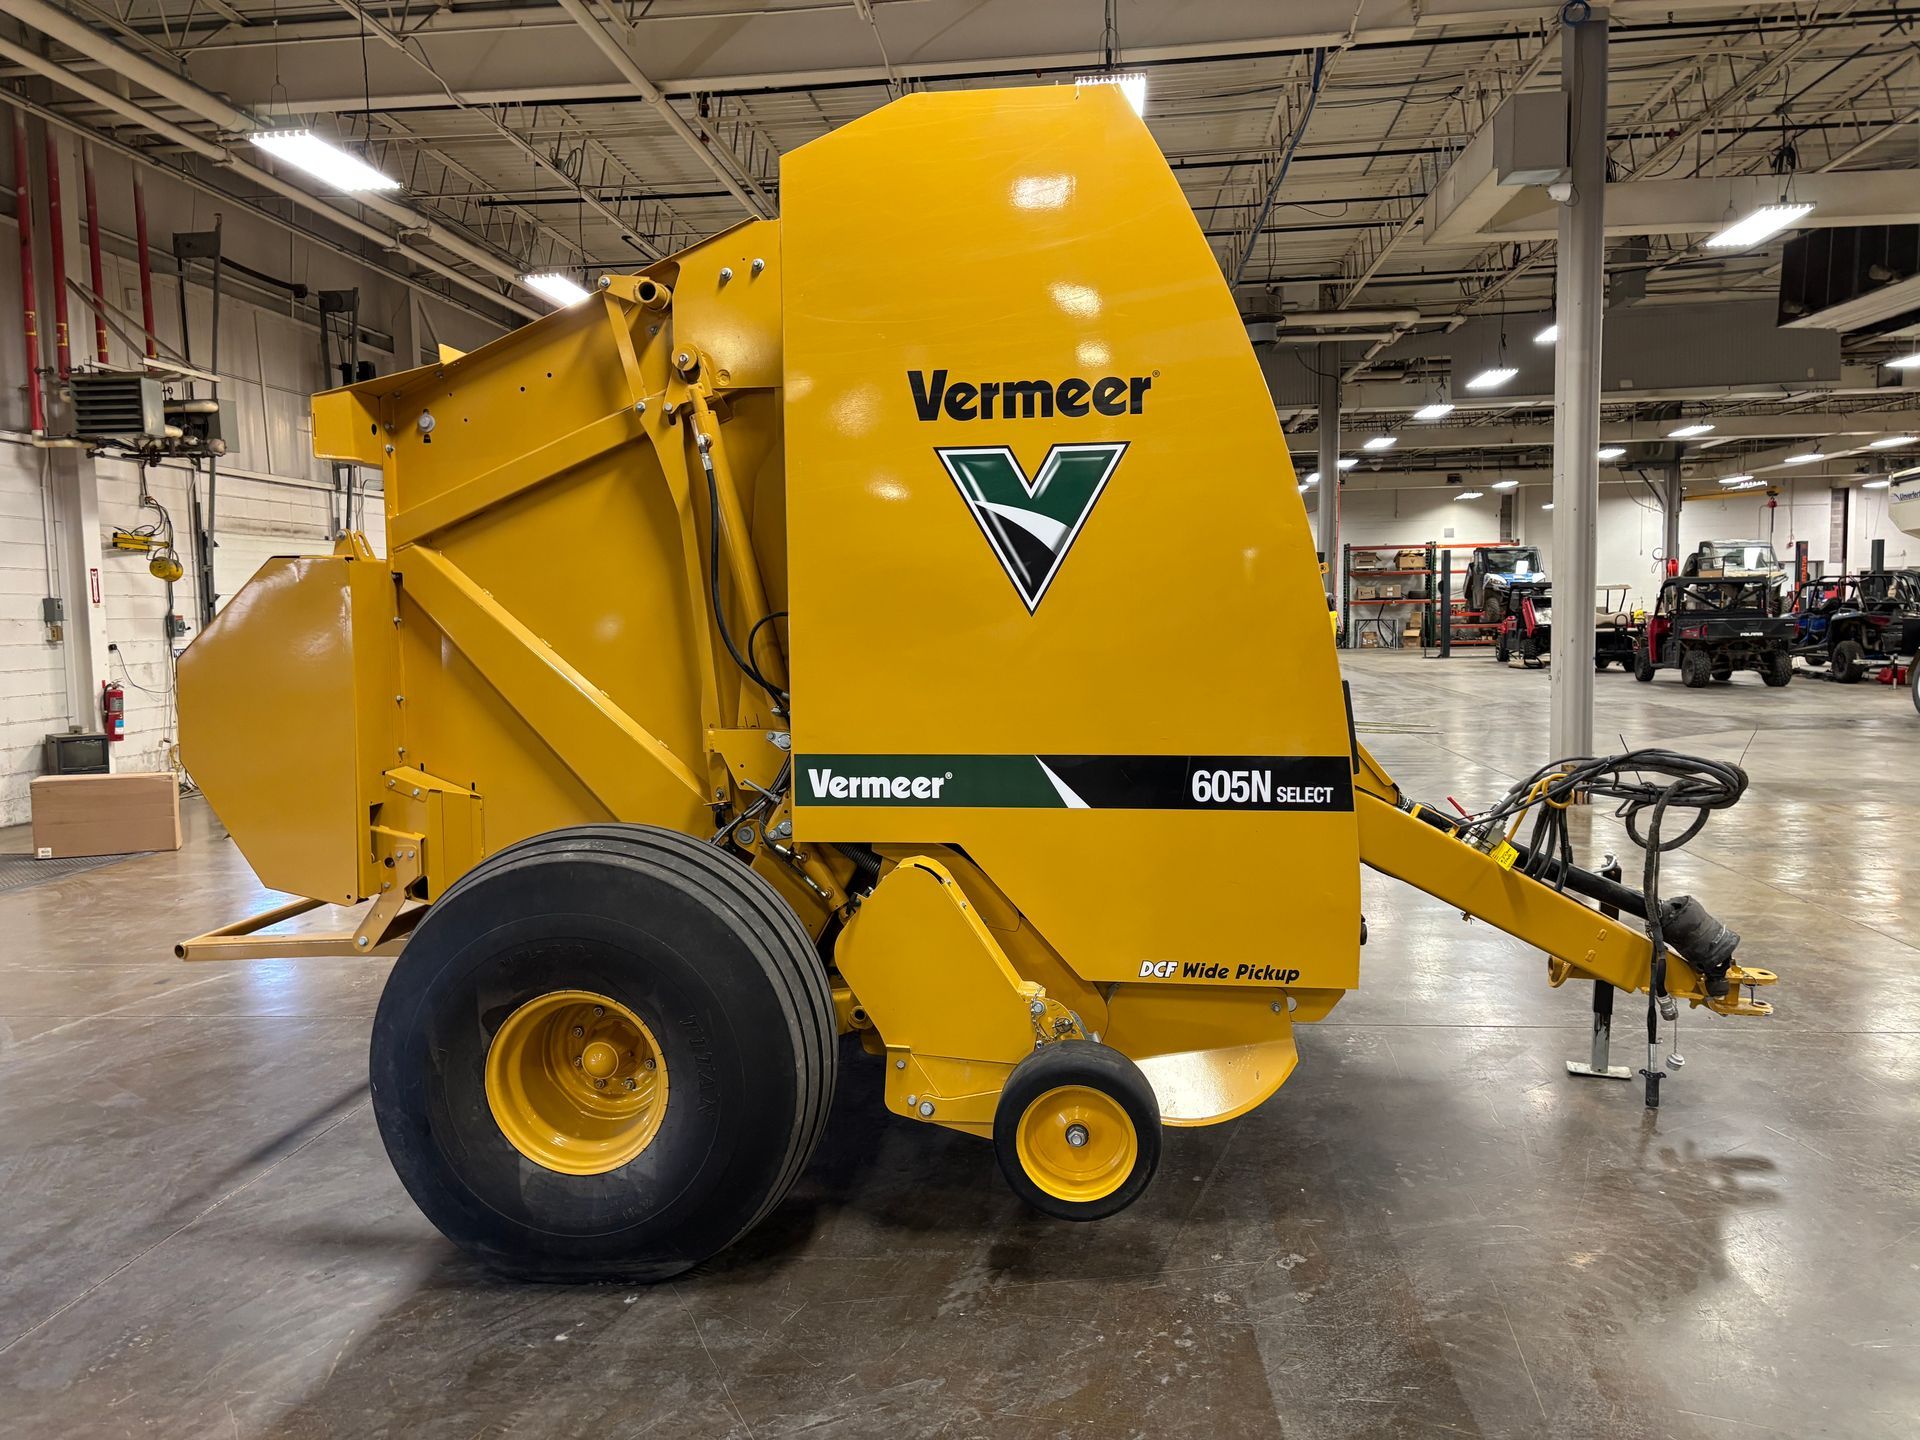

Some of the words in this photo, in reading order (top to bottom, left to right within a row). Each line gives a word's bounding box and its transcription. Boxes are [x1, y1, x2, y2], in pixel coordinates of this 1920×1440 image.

[1191, 769, 1272, 803] 605N
[1276, 786, 1334, 803] SELECT
[1138, 959, 1179, 978] DCF
[1182, 961, 1230, 979] Wide
[1235, 963, 1300, 984] Pickup
